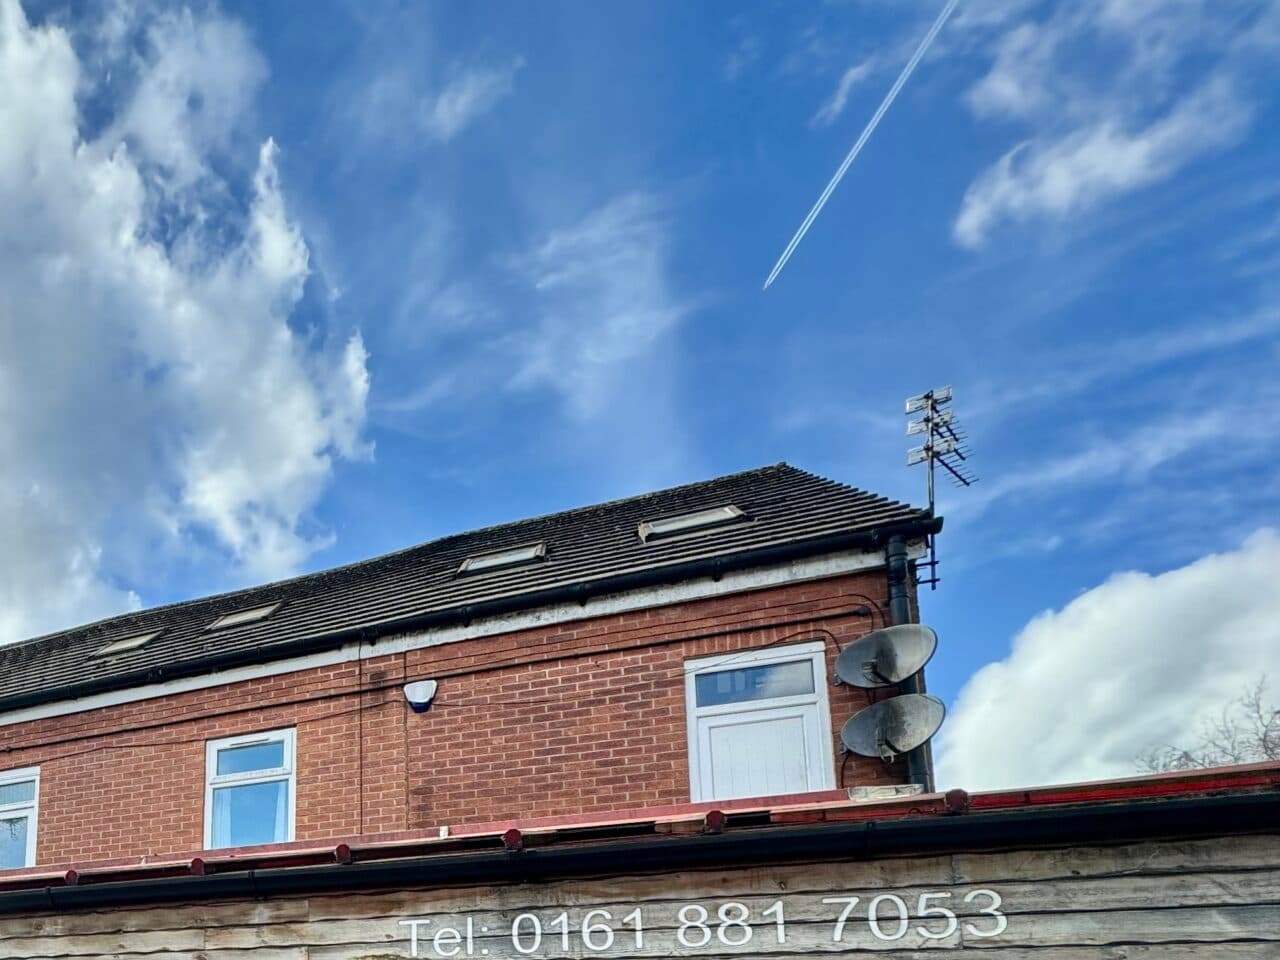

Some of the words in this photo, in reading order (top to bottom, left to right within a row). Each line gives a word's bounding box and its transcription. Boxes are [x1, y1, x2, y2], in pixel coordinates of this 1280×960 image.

[398, 916, 489, 957] Tel:
[511, 907, 643, 954] 0161
[676, 902, 786, 947] 881
[822, 889, 1008, 942] 7053
